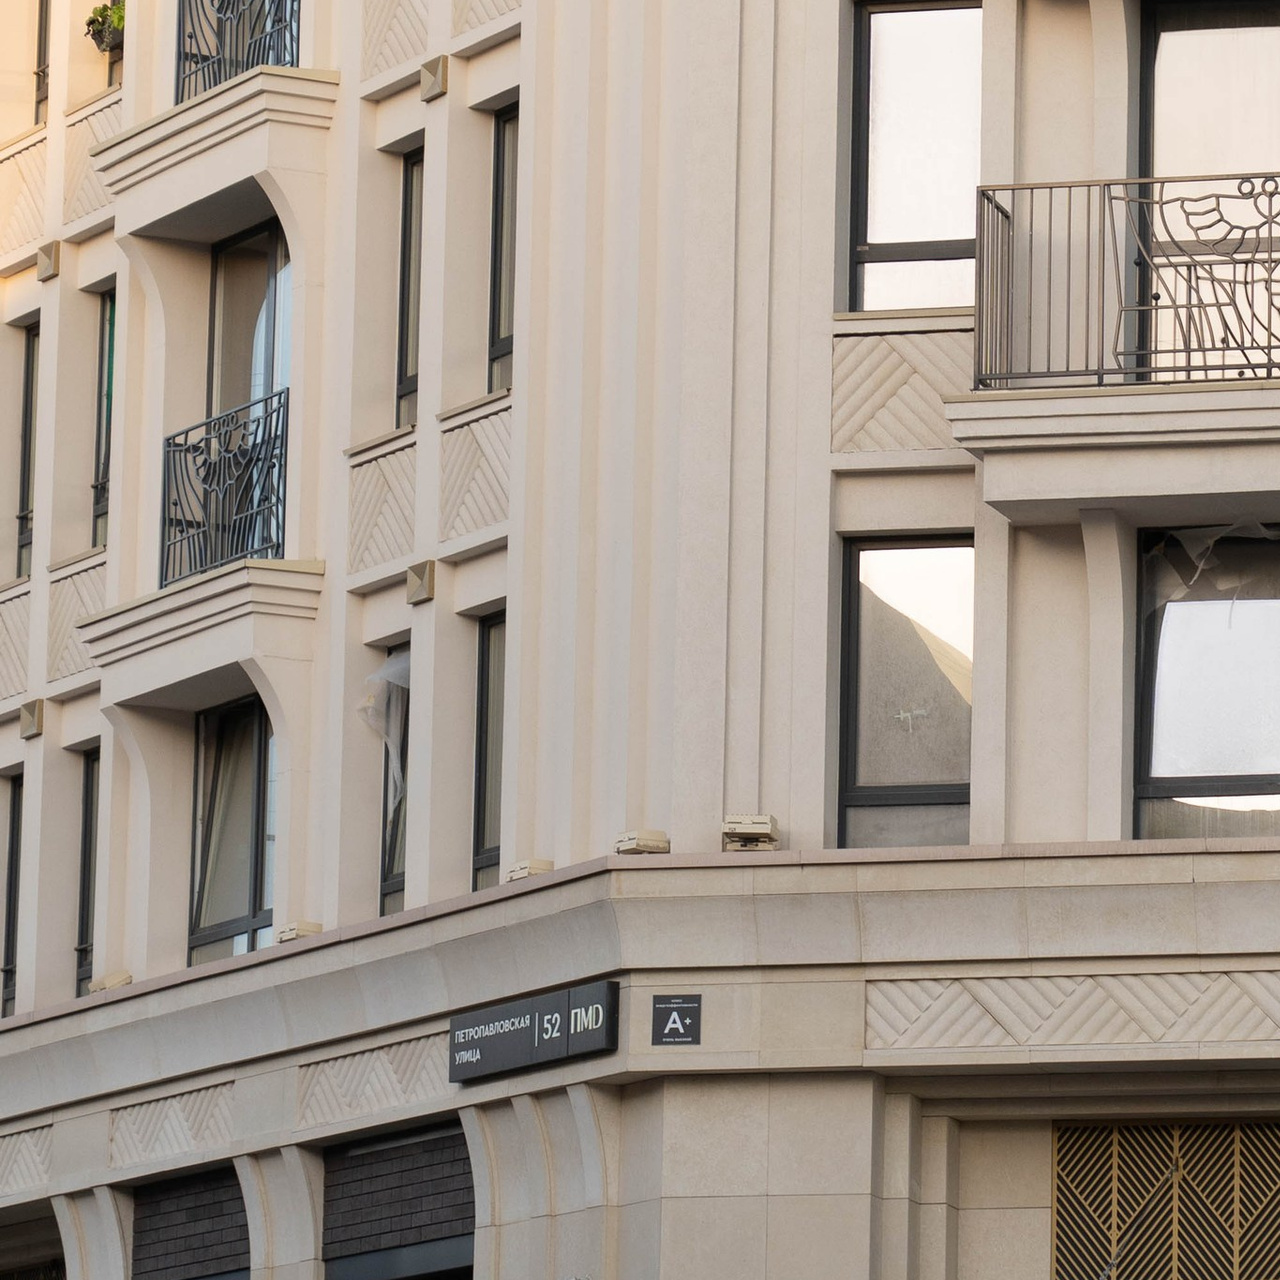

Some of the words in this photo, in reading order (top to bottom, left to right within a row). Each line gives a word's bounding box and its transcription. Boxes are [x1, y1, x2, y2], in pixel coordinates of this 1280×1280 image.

[455, 1015, 530, 1043] ПЕТРОПАВЛОВСКАЯ
[543, 1013, 561, 1040] 52
[455, 1048, 481, 1065] УЛИЦА
